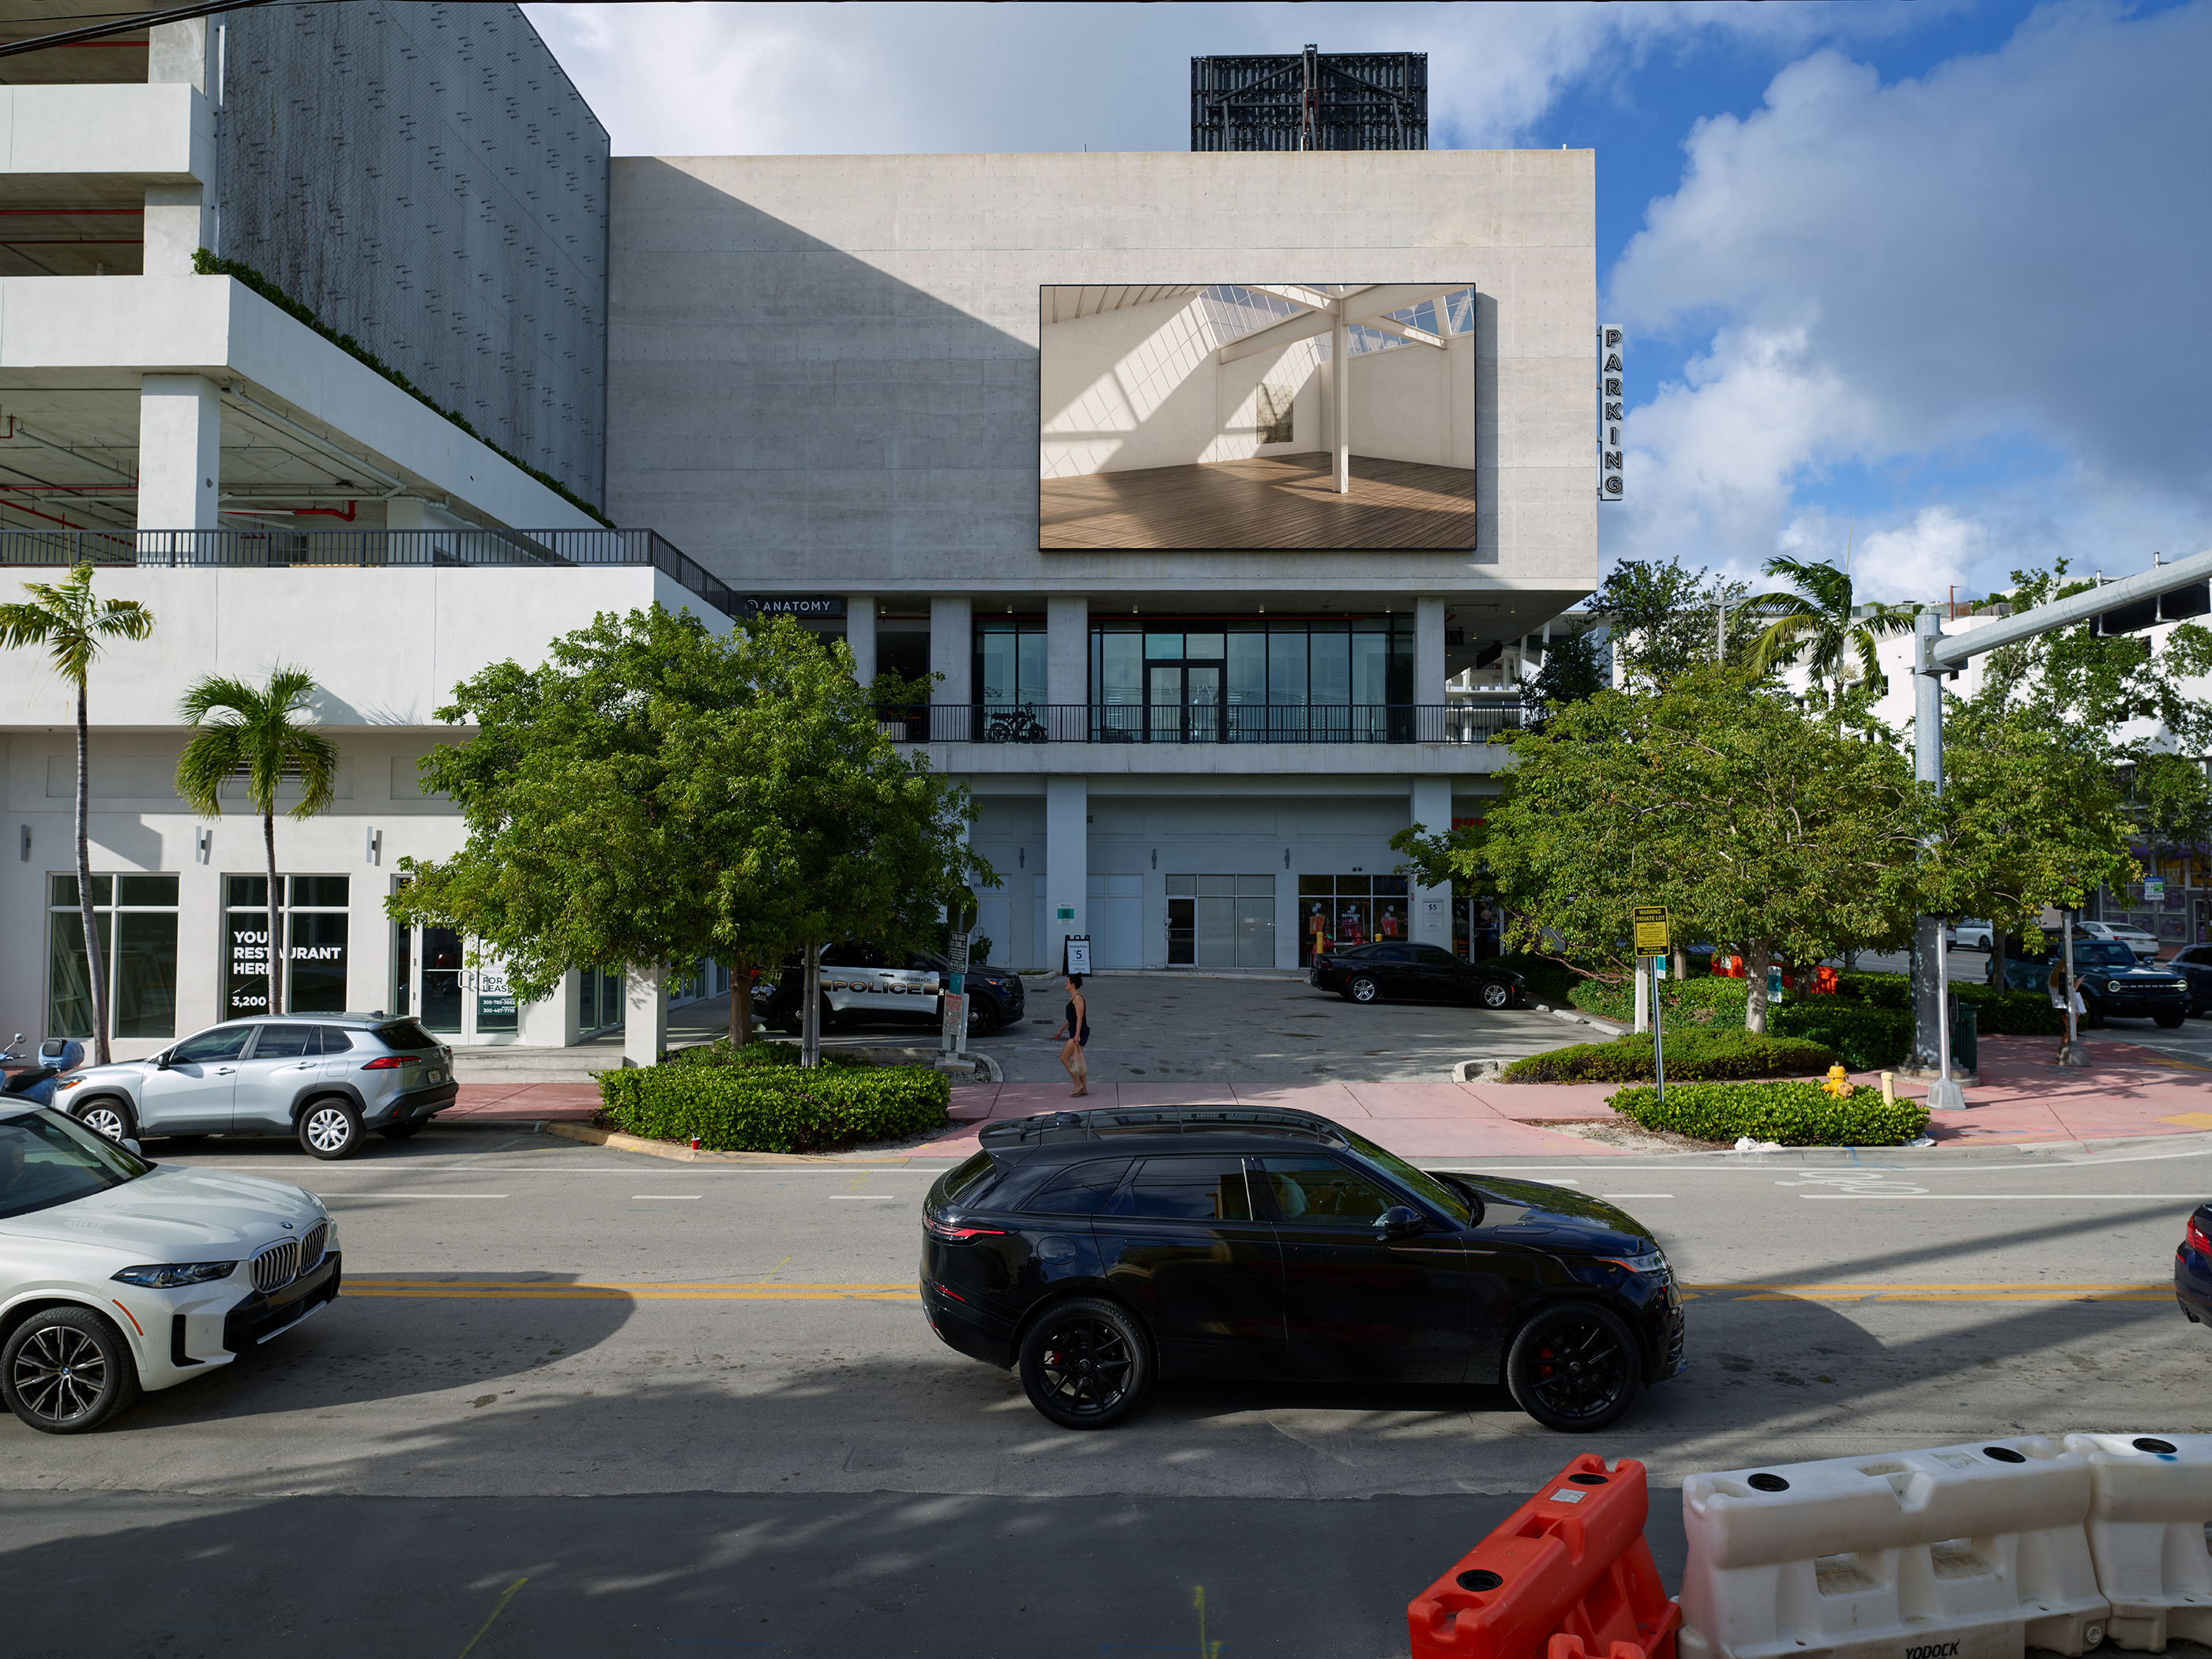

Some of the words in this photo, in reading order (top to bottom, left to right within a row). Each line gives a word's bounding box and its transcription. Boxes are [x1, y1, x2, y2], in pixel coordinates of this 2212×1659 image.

[1604, 329, 1622, 493] PARKING
[762, 601, 830, 611] ANATOMY
[1452, 817, 1487, 830] DUN
[234, 931, 268, 943] YOU
[833, 980, 922, 995] POLICE
[231, 996, 267, 1007] 3,200
[1905, 1642, 1960, 1659] YODOCK
